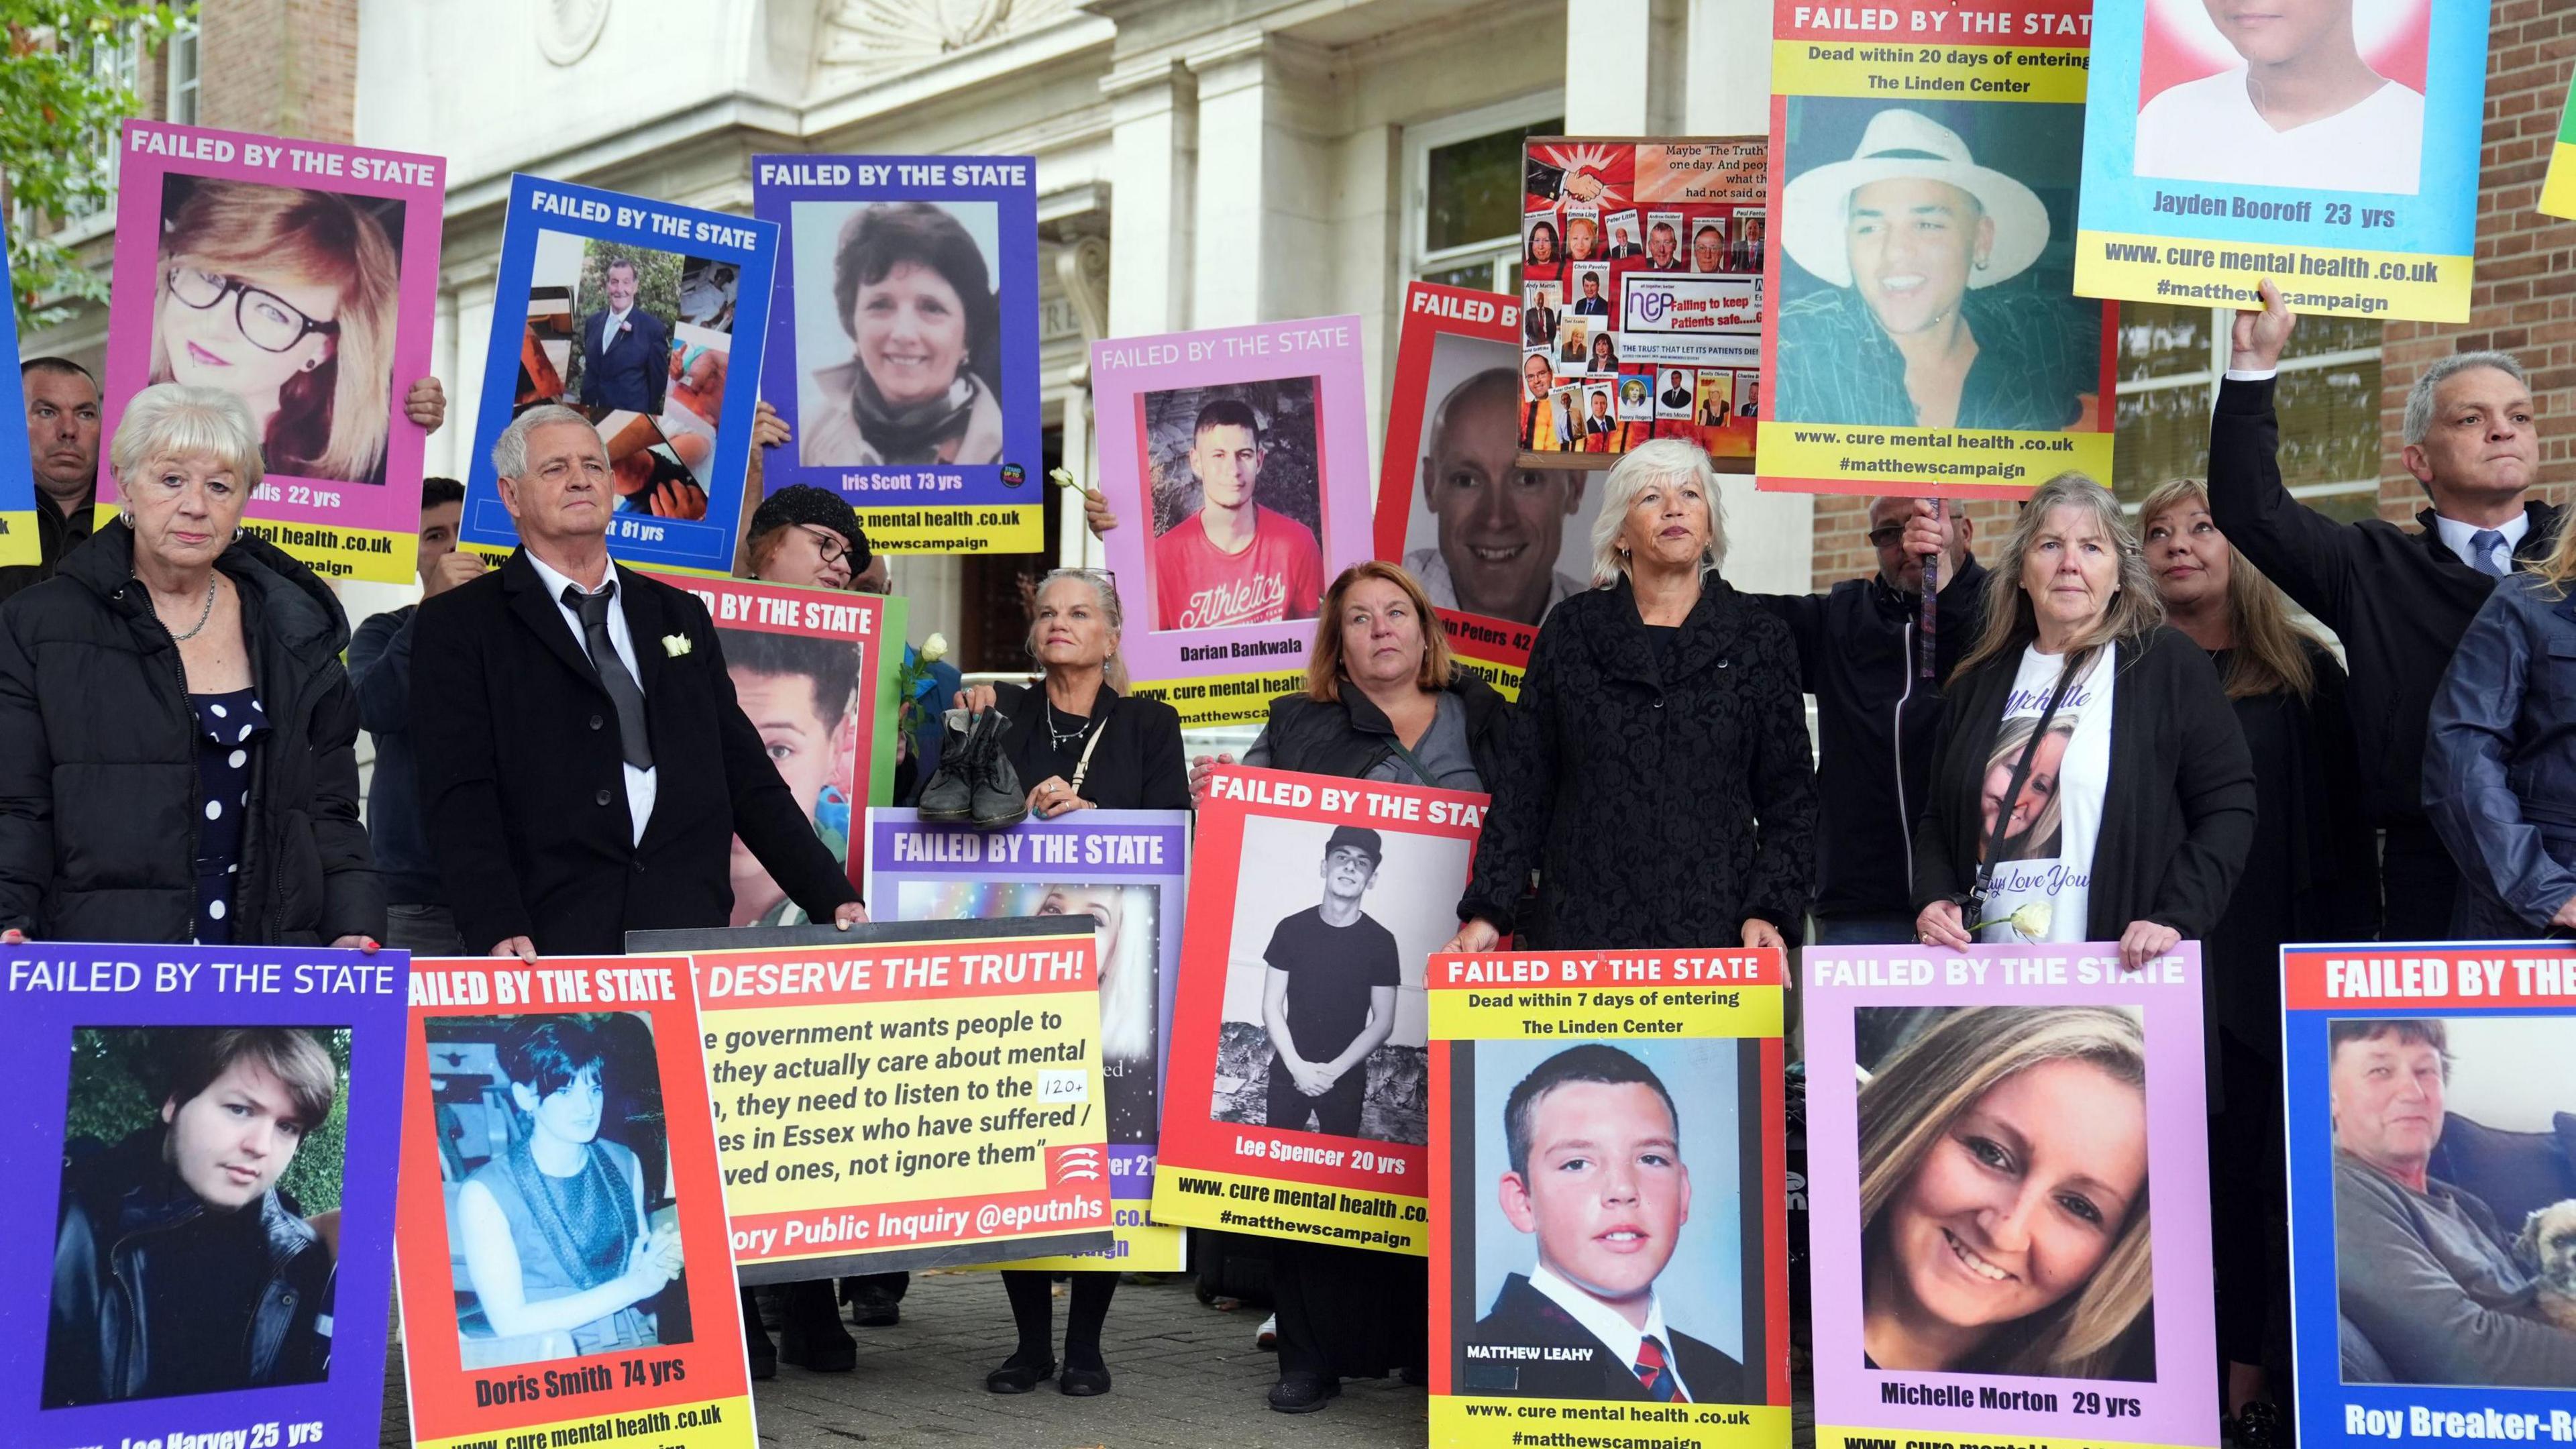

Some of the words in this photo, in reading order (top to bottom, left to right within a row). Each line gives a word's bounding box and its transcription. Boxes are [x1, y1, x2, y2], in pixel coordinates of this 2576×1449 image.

[1794, 7, 1898, 31] FAILED
[1911, 11, 1947, 32] BY
[1960, 12, 2011, 34] THE
[1808, 46, 1854, 61] Dead
[1860, 47, 1914, 63] within
[1919, 50, 1941, 64] 20
[1946, 50, 1988, 67] days
[1992, 52, 2012, 65] of
[2017, 53, 2091, 69] entering
[1868, 75, 1899, 91] The
[1905, 76, 1964, 92] Linden
[1970, 78, 2031, 93] Center
[131, 129, 235, 163] FAILED
[244, 144, 282, 169] BY
[290, 150, 343, 177] THE
[350, 157, 435, 187] STATE
[1666, 146, 1701, 156] Maybe
[1693, 160, 1714, 171] day.
[1718, 160, 1739, 169] And
[760, 164, 851, 186] FAILED
[859, 164, 892, 185] BY
[898, 165, 946, 186] THE
[952, 166, 1026, 186] STATE
[1726, 175, 1751, 184] what
[1686, 188, 1707, 198] had
[1709, 189, 1727, 197] not
[1730, 188, 1752, 197] said
[2153, 191, 2227, 218] Jayden
[2232, 197, 2312, 223] Booroff
[2325, 203, 2351, 225] 23
[2361, 206, 2395, 229] yrs
[2105, 242, 2162, 266] www.
[2166, 246, 2214, 269] cure
[2220, 252, 2296, 275] mental
[2300, 257, 2369, 280] health
[2373, 261, 2438, 283] .co.uk
[1412, 292, 1495, 323] FAILED
[1671, 300, 1706, 312] Failing
[1710, 299, 1720, 309] to
[1723, 297, 1749, 309] keep
[2157, 280, 2388, 312] #matthewcampaign
[1671, 317, 1714, 329] Patients
[842, 474, 869, 490] Iris
[872, 473, 911, 490] Scott
[918, 474, 935, 489] 73
[938, 475, 962, 491] yrs
[1839, 457, 2025, 478] #matthewscampaign
[288, 485, 309, 504] 22
[313, 490, 341, 508] yrs
[622, 519, 638, 537] 81
[641, 525, 664, 542] yrs
[1180, 572, 1285, 630] Athletics
[1181, 645, 1228, 661] Darian
[1232, 638, 1302, 657] Bankwala
[1460, 621, 1507, 646] Peters
[1512, 633, 1531, 651] 42
[1174, 686, 1205, 700] cure
[1210, 679, 1259, 698] mental
[1210, 775, 1313, 808] FAILED
[1320, 788, 1361, 813] BY
[1366, 794, 1420, 821] THE
[2008, 869, 2045, 893] Love
[2047, 865, 2090, 896] You
[708, 960, 871, 998] DESERVE
[881, 956, 951, 989] THE
[959, 950, 1084, 985] TRUTH!
[1448, 961, 1549, 983] FAILED
[1562, 960, 1599, 981] BY
[1609, 959, 1661, 981] THE
[1672, 957, 1758, 979] STATE
[2326, 959, 2449, 998] FAILED
[2457, 959, 2505, 996] BY
[2513, 958, 2576, 996] THE
[1468, 994, 1513, 1008] Dead
[1518, 993, 1572, 1008] within
[1577, 993, 1588, 1006] 7
[1593, 992, 1634, 1009] days
[1640, 992, 1658, 1006] of
[1662, 991, 1740, 1008] entering
[725, 1020, 873, 1054] government
[880, 1016, 949, 1040] wants
[956, 1010, 1034, 1040] people
[1041, 1011, 1062, 1030] to
[712, 1060, 768, 1087] they
[773, 1053, 871, 1080] actually
[877, 1053, 928, 1073] care
[935, 1045, 1002, 1070] about
[1008, 1038, 1086, 1065] mental
[737, 1092, 790, 1120] they
[797, 1086, 857, 1112] need
[864, 1087, 888, 1108] to
[894, 1081, 960, 1105] listen
[967, 1079, 989, 1101] to
[996, 1075, 1032, 1096] the
[1045, 1080, 1083, 1095] 120+
[753, 1127, 775, 1150] in
[782, 1124, 855, 1148] Essex
[862, 1117, 910, 1140] who
[917, 1115, 972, 1137] have
[979, 1105, 1076, 1131] suffered
[775, 1161, 840, 1182] ones,
[849, 1153, 888, 1176] not
[895, 1149, 970, 1177] ignore
[1236, 1136, 1266, 1157] Lee
[1269, 1139, 1344, 1167] Spencer
[1350, 1150, 1373, 1171] 20
[1378, 1155, 1405, 1175] yrs
[784, 1215, 870, 1246] Public
[877, 1205, 970, 1242] Inquiry
[976, 1194, 1103, 1235] @eputnhs
[1220, 1210, 1411, 1247] #matthewscampaign
[1467, 1346, 1540, 1359] MATTHEW
[1544, 1347, 1593, 1361] LEAHY
[475, 1375, 538, 1408] Doris
[545, 1364, 612, 1399] Smith
[620, 1359, 647, 1388] 74
[651, 1357, 686, 1387] yrs
[1881, 1383, 1974, 1408] Michelle
[1980, 1389, 2057, 1412] Morton
[2072, 1392, 2101, 1413] 29
[2106, 1396, 2141, 1417] yrs
[166, 1430, 248, 1449] Harvey
[250, 1422, 280, 1448] 25
[288, 1421, 323, 1447] yrs
[2345, 1404, 2403, 1440] Roy
